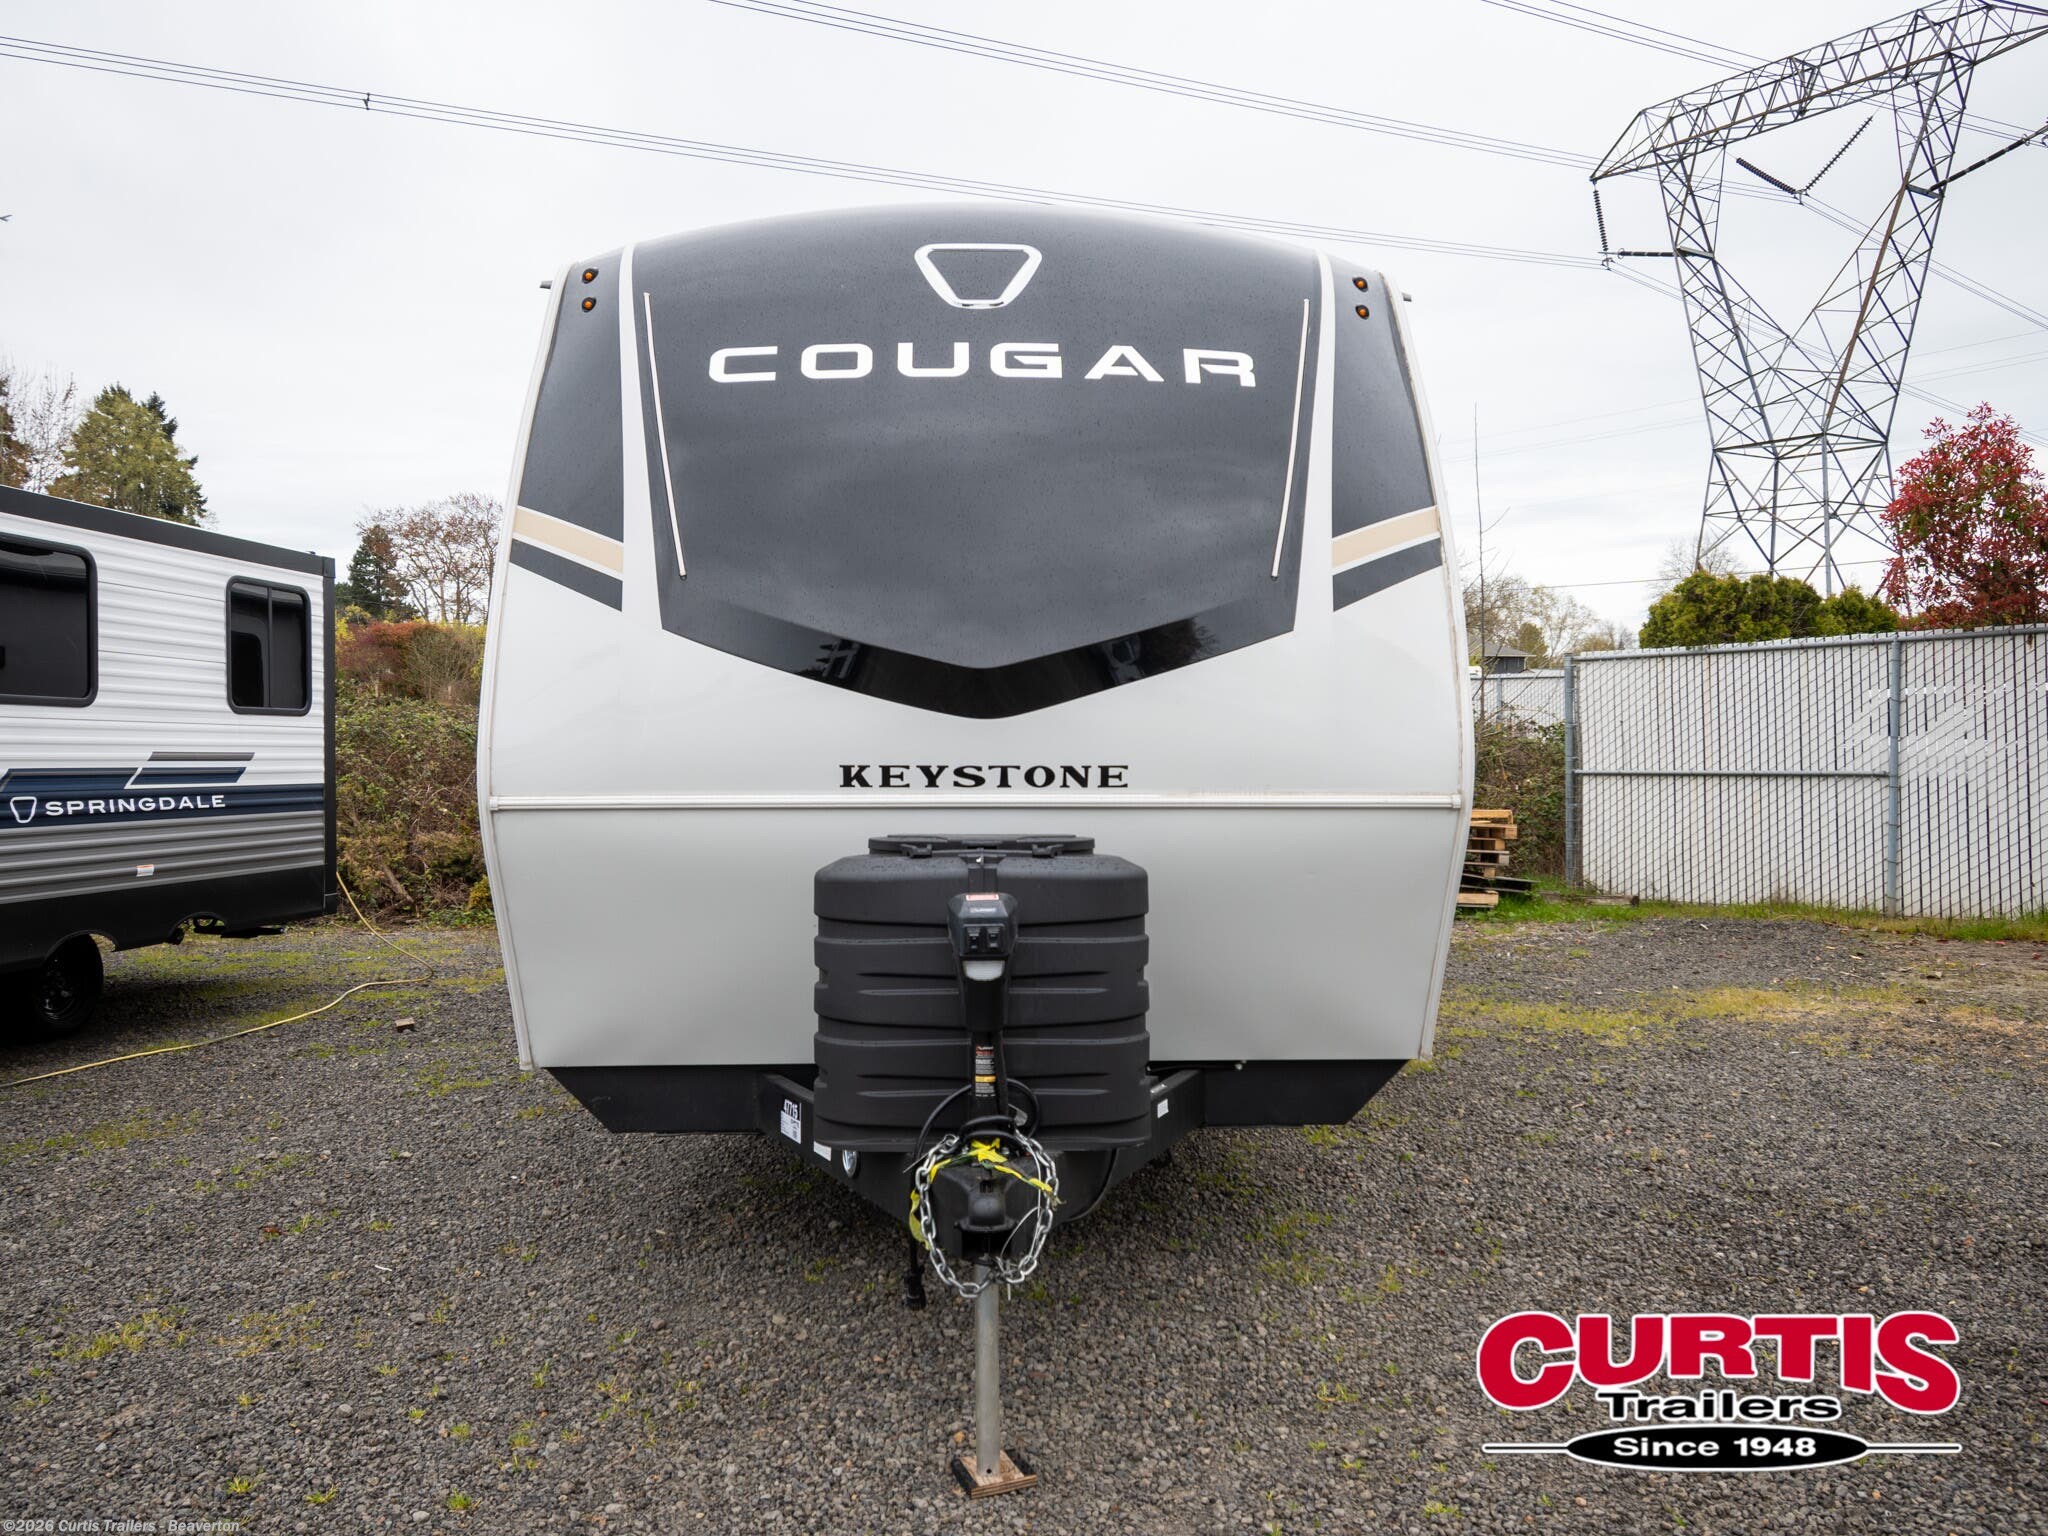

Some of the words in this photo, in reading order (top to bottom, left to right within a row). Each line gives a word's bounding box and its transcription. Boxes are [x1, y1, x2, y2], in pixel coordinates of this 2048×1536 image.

[708, 341, 1257, 388] COUGAR
[839, 764, 1129, 789] KEYSTONE
[45, 794, 226, 816] SPRINGDALE
